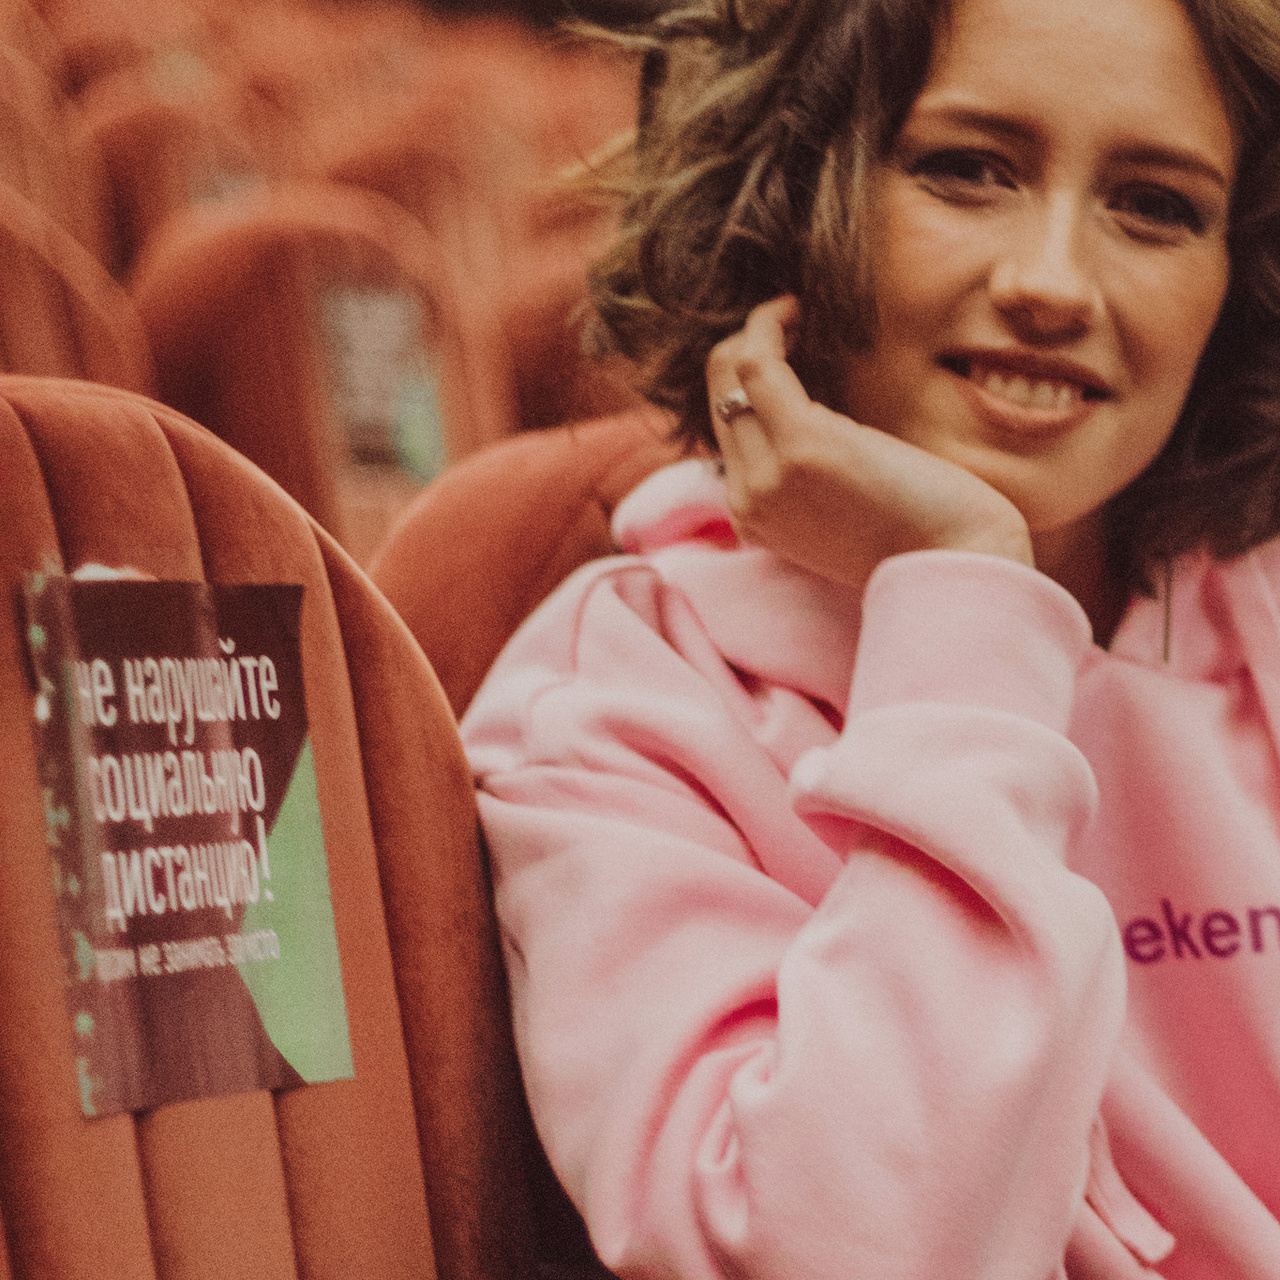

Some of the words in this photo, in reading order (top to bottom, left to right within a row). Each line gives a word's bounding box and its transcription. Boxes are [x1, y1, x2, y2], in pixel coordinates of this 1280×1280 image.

[122, 636, 281, 747] нарушайте
[89, 746, 266, 835] социальную
[101, 814, 275, 933] дистанцию!
